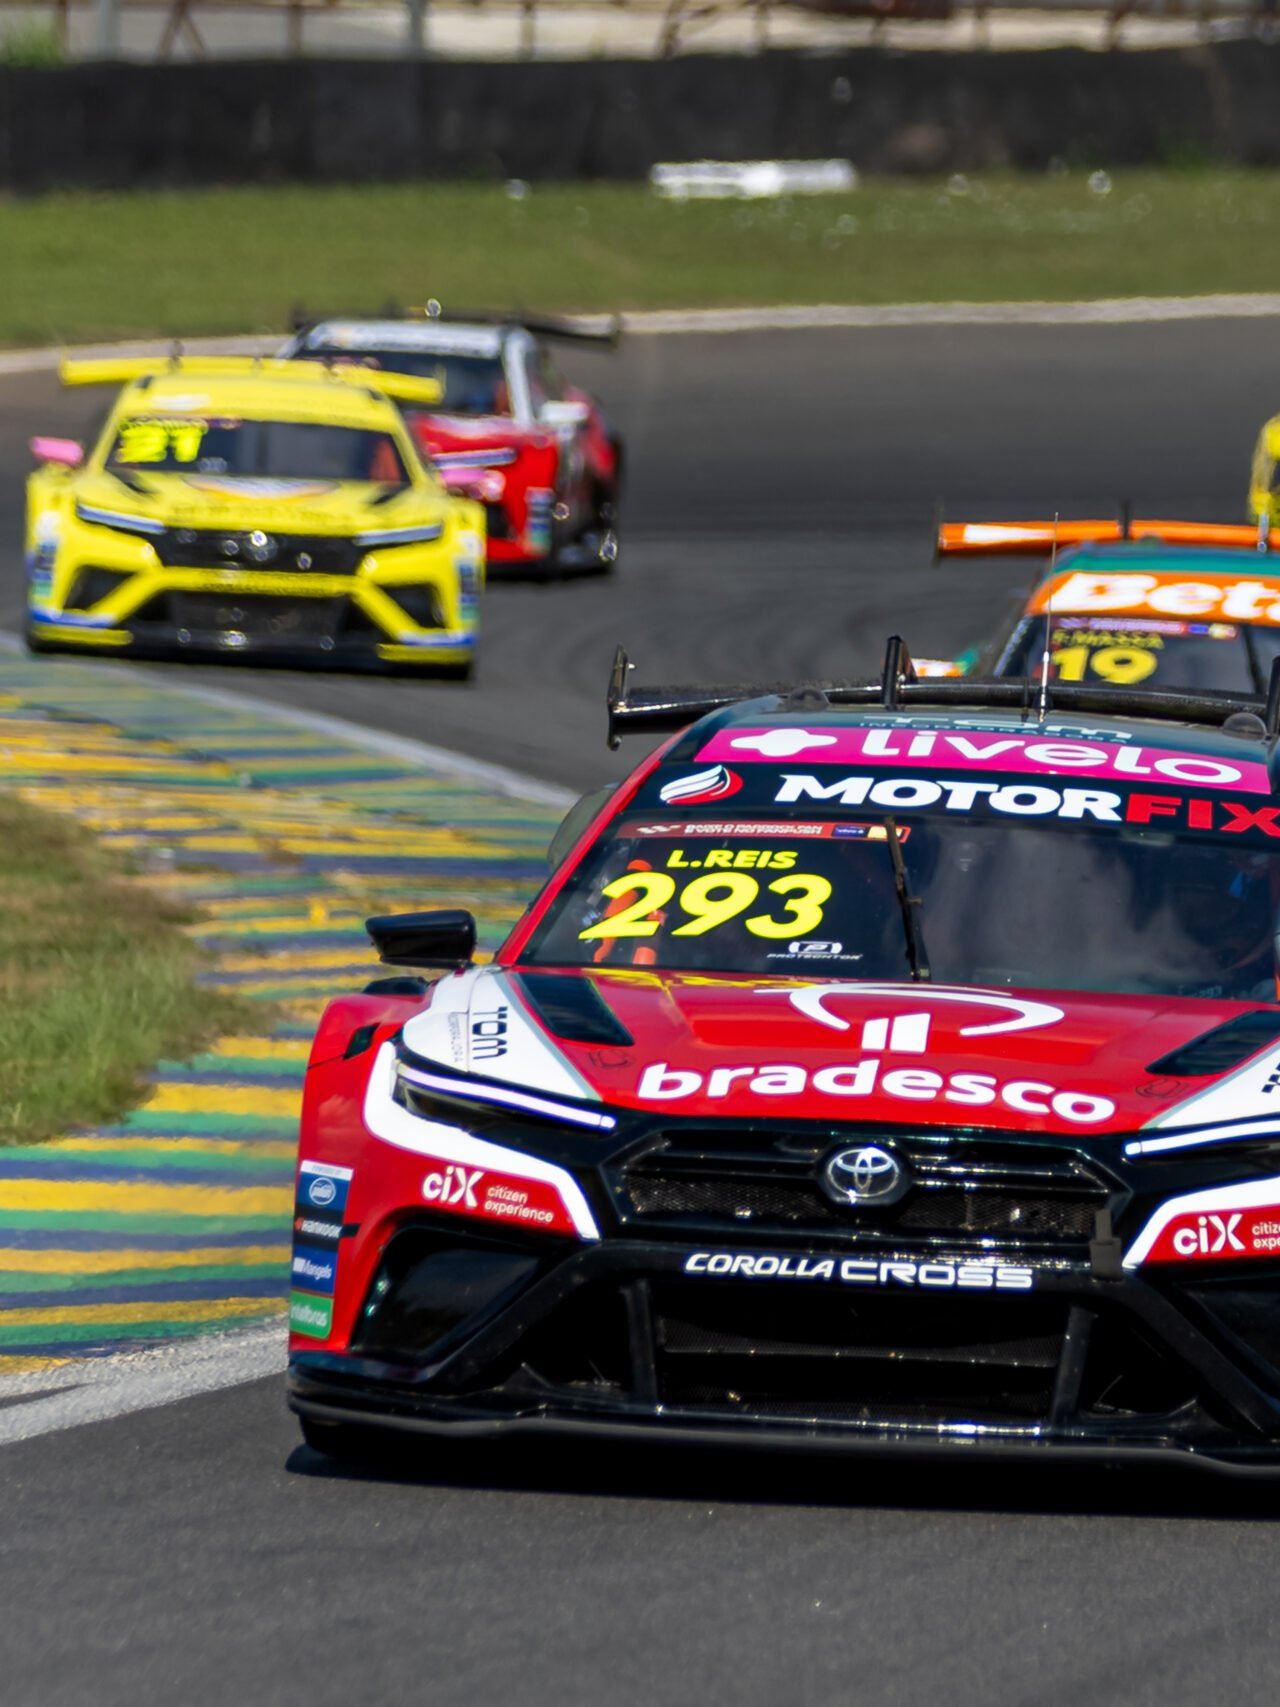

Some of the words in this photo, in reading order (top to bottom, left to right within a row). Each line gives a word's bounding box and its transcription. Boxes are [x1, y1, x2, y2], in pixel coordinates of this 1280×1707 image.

[1051, 646, 1158, 684] 19
[861, 728, 1242, 784] livelo
[666, 849, 799, 869] L.REIS
[578, 871, 833, 939] 293
[637, 1059, 1115, 1122] bradesco
[484, 1199, 554, 1223] experience
[487, 1185, 528, 1204] citizen
[685, 1253, 835, 1278] COROLLA
[841, 1262, 1033, 1288] CROSS
